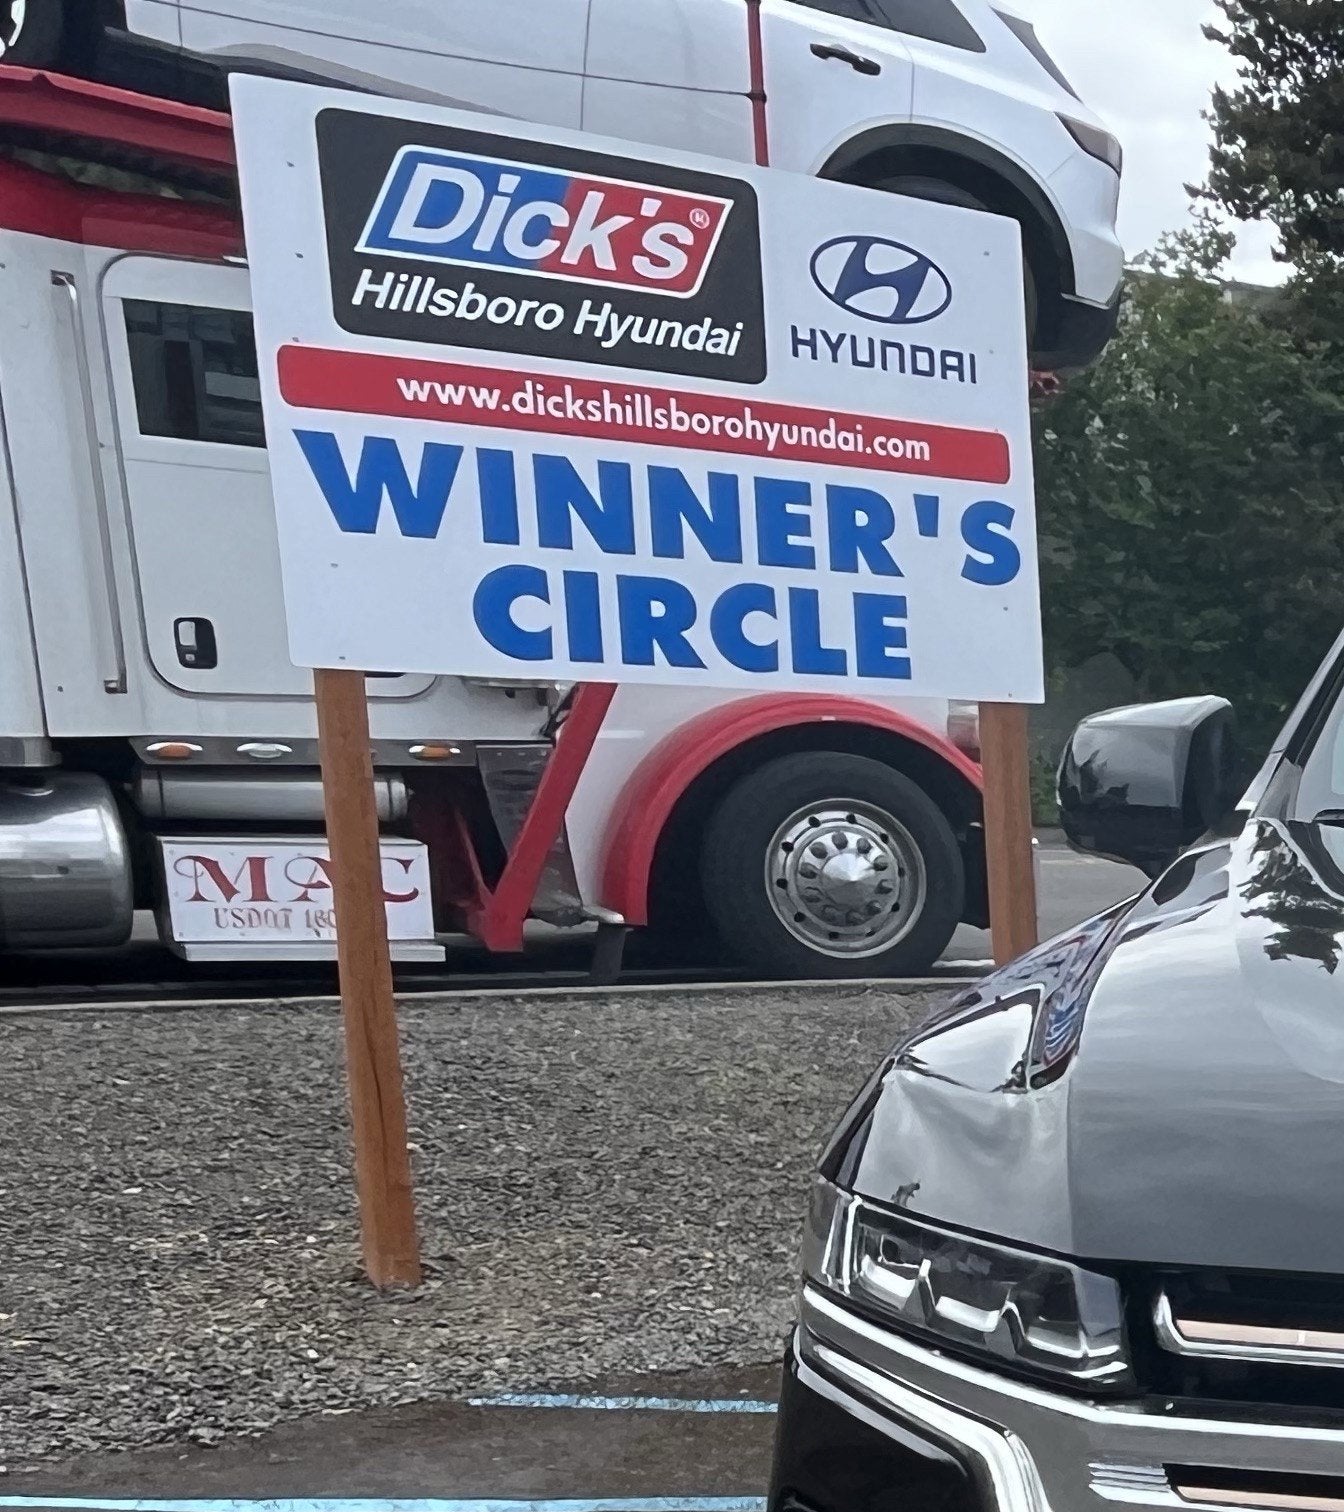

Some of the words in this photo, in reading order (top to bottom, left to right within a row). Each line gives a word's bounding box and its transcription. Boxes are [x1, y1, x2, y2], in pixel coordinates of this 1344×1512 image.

[388, 162, 695, 280] Dick's
[351, 269, 565, 331] Hillsboro
[573, 299, 745, 357] Hyundai
[790, 325, 977, 384] HYUNDAI
[396, 376, 931, 463] www.dickshillsborohyundai.com
[293, 429, 1022, 586] WINNER'S
[472, 563, 913, 681] CIRCLE
[213, 907, 293, 929] USDOT
